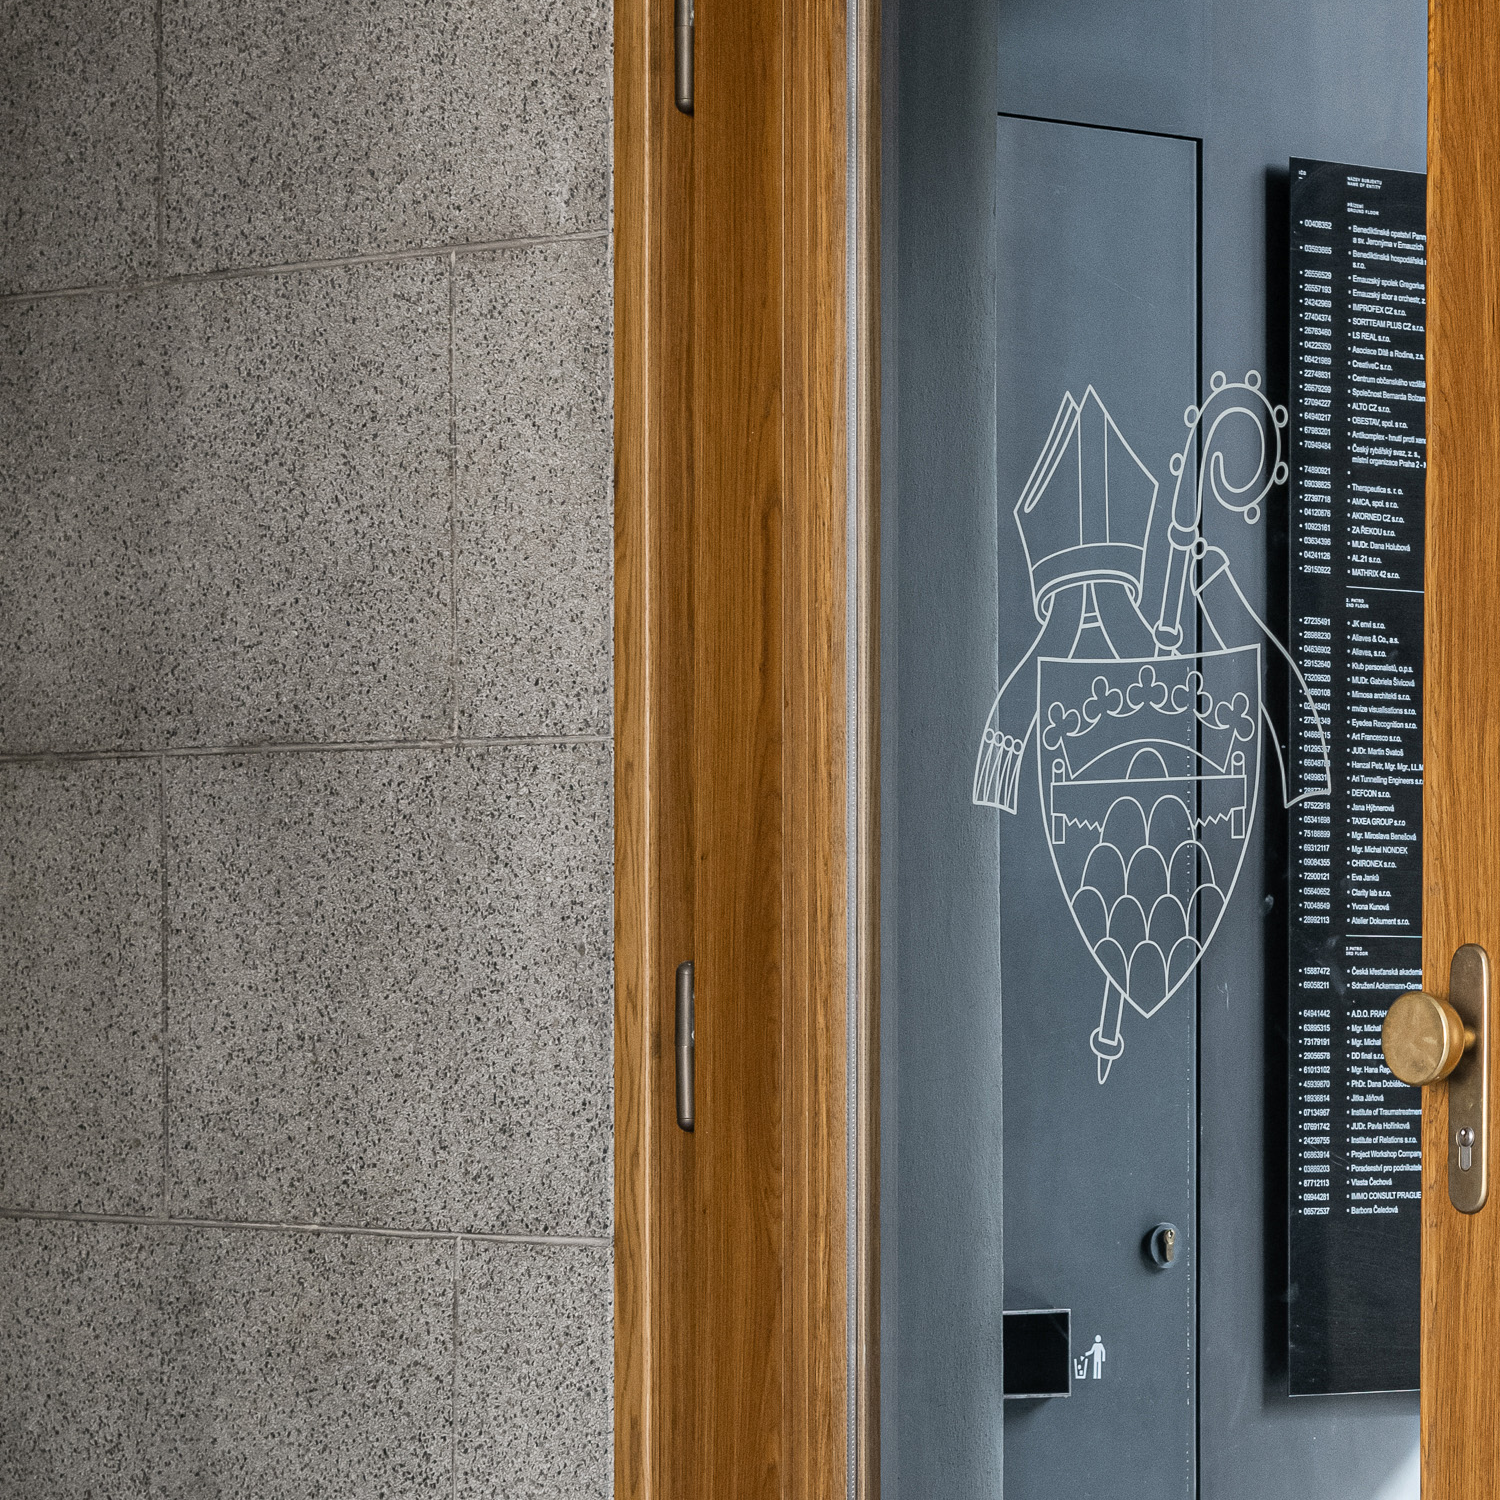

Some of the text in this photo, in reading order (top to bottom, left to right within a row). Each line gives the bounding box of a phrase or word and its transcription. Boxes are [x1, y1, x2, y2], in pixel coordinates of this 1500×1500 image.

[1353, 318, 1385, 327] SORTTEAM
[1387, 321, 1402, 330] PLUS
[1403, 323, 1411, 331] CZ
[1352, 845, 1363, 855] Mgr.
[1383, 846, 1407, 854] NONDEK
[1369, 1177, 1392, 1186] Čechová
